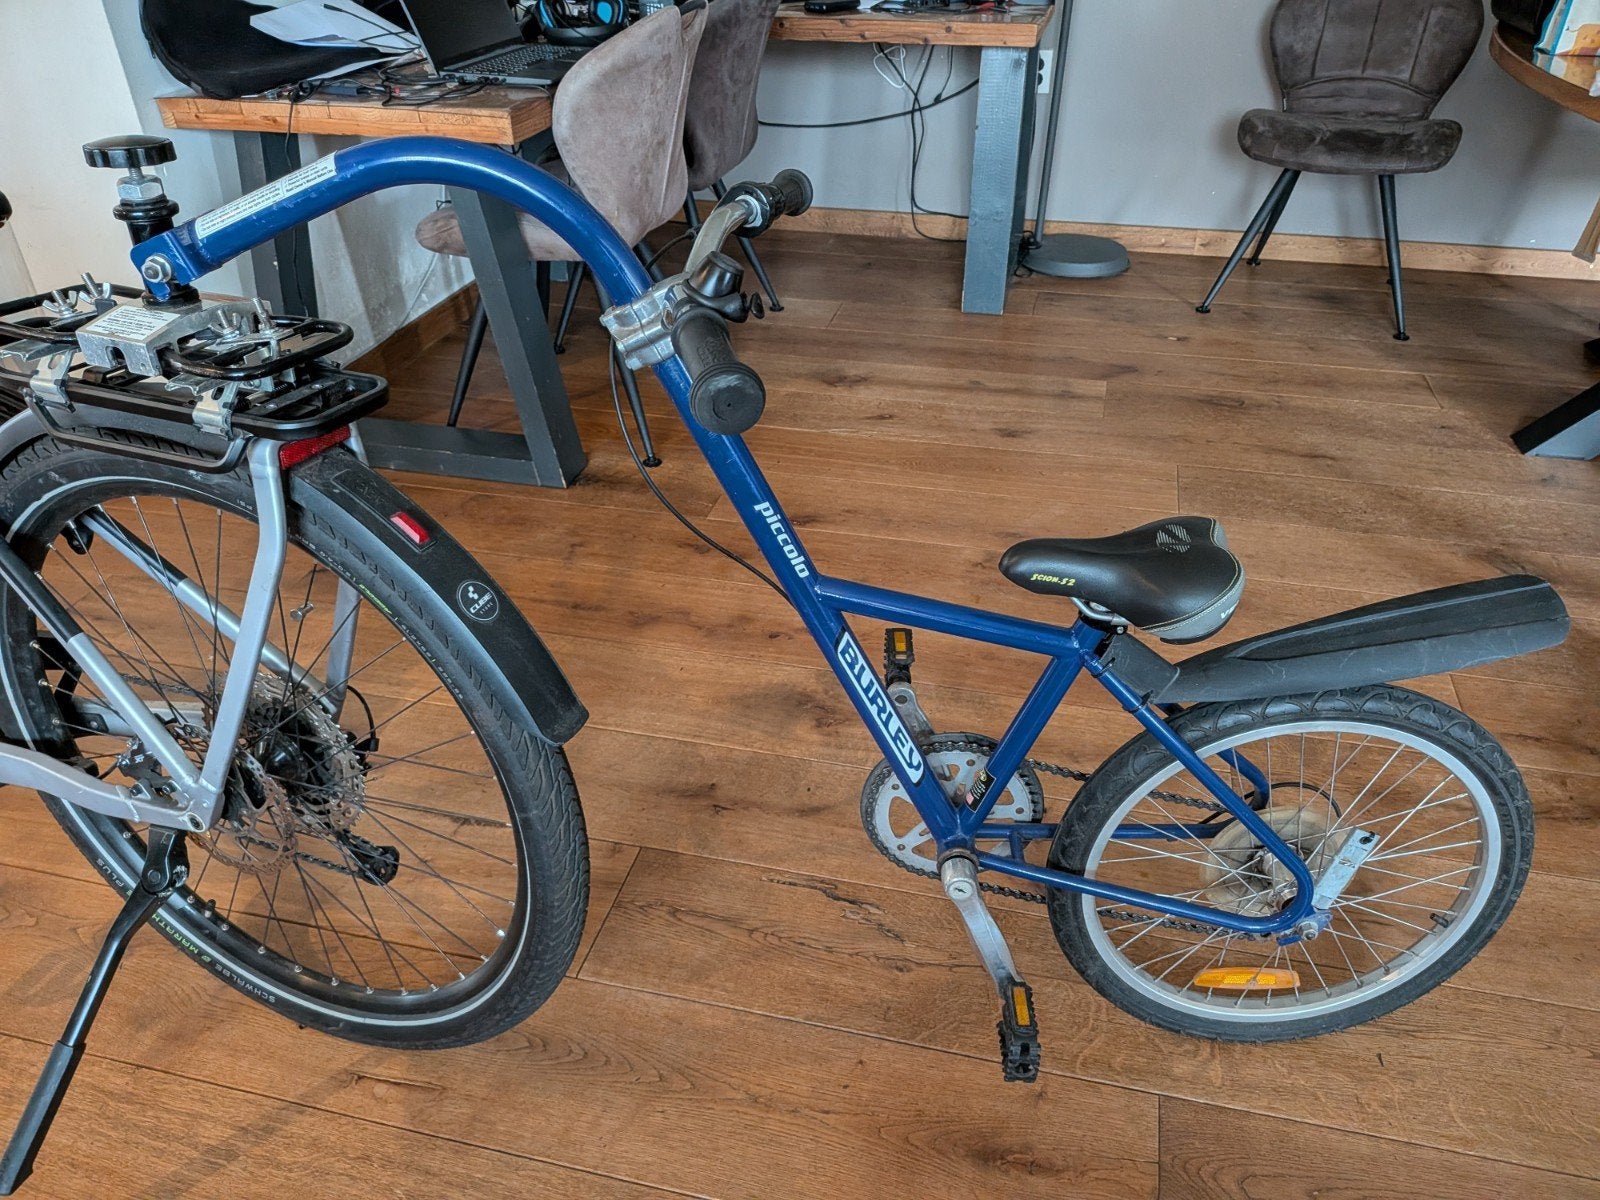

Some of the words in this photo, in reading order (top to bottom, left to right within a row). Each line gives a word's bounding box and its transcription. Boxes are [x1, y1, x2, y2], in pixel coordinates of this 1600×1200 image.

[470, 592, 492, 613] CUBE
[840, 641, 922, 770] BURLEY
[96, 859, 125, 887] PLUS
[152, 913, 198, 954] MARATH
[215, 963, 276, 1003] SCHWALBE
